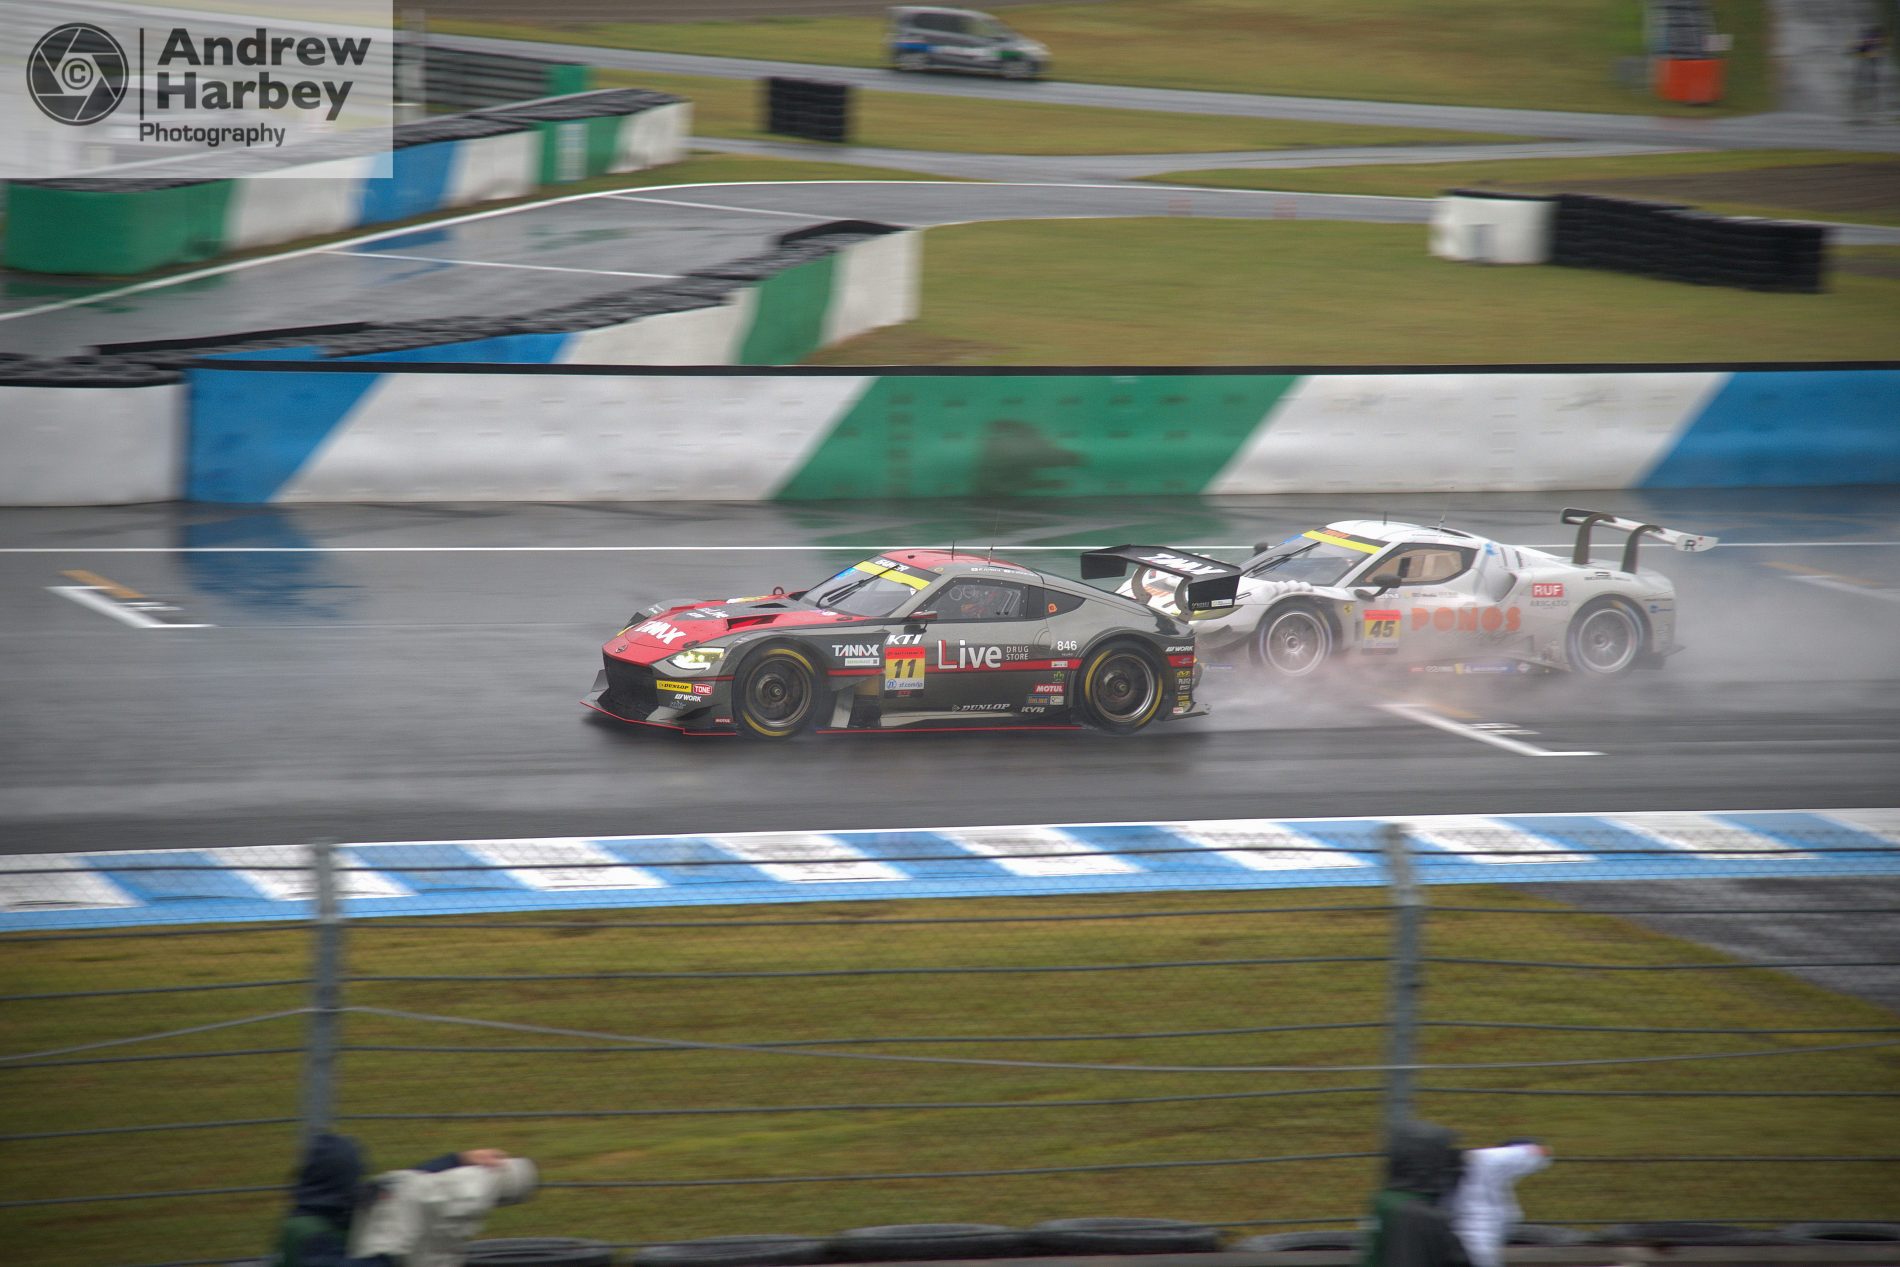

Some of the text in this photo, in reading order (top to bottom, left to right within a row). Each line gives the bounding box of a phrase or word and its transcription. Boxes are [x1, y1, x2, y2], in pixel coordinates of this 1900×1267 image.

[1533, 584, 1562, 596] RUF
[1411, 606, 1521, 632] PONOS
[1369, 620, 1395, 638] 45
[886, 634, 923, 645] KTI
[831, 643, 880, 656] TANAX
[1006, 645, 1029, 653] DRUG
[1057, 640, 1077, 651] 846
[937, 640, 1002, 670] Live
[1005, 652, 1029, 661] STORE
[894, 659, 917, 679] 11
[694, 685, 711, 694] TONE
[1035, 685, 1063, 693] MOTUL
[683, 694, 702, 702] WORK
[961, 703, 1011, 712] DUNLOP
